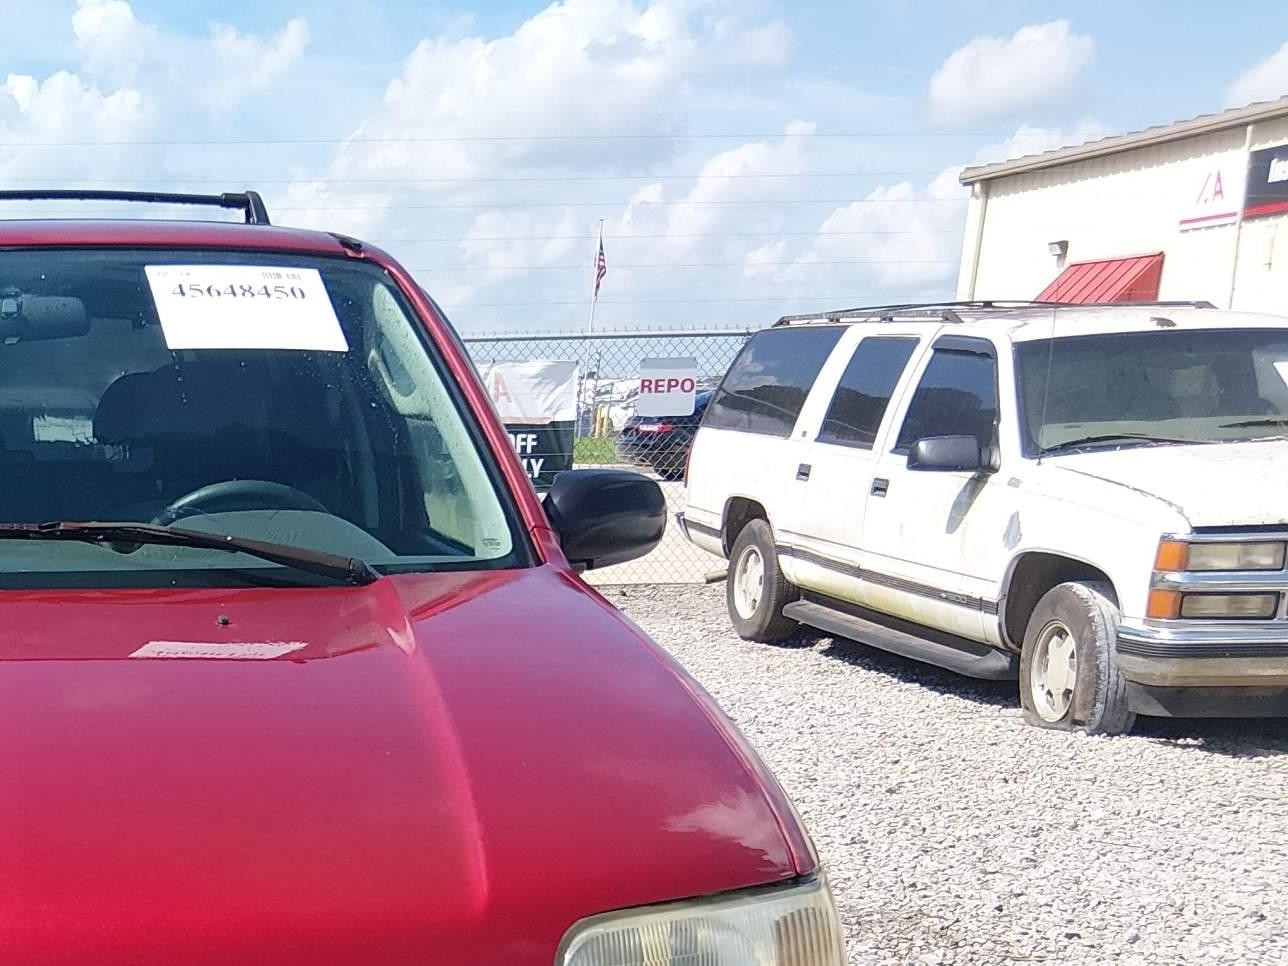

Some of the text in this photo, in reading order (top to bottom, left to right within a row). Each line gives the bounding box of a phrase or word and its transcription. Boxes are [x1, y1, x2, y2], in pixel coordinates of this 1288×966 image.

[172, 283, 307, 301] 45648450
[640, 378, 695, 394] REPO
[521, 458, 544, 479] LY
